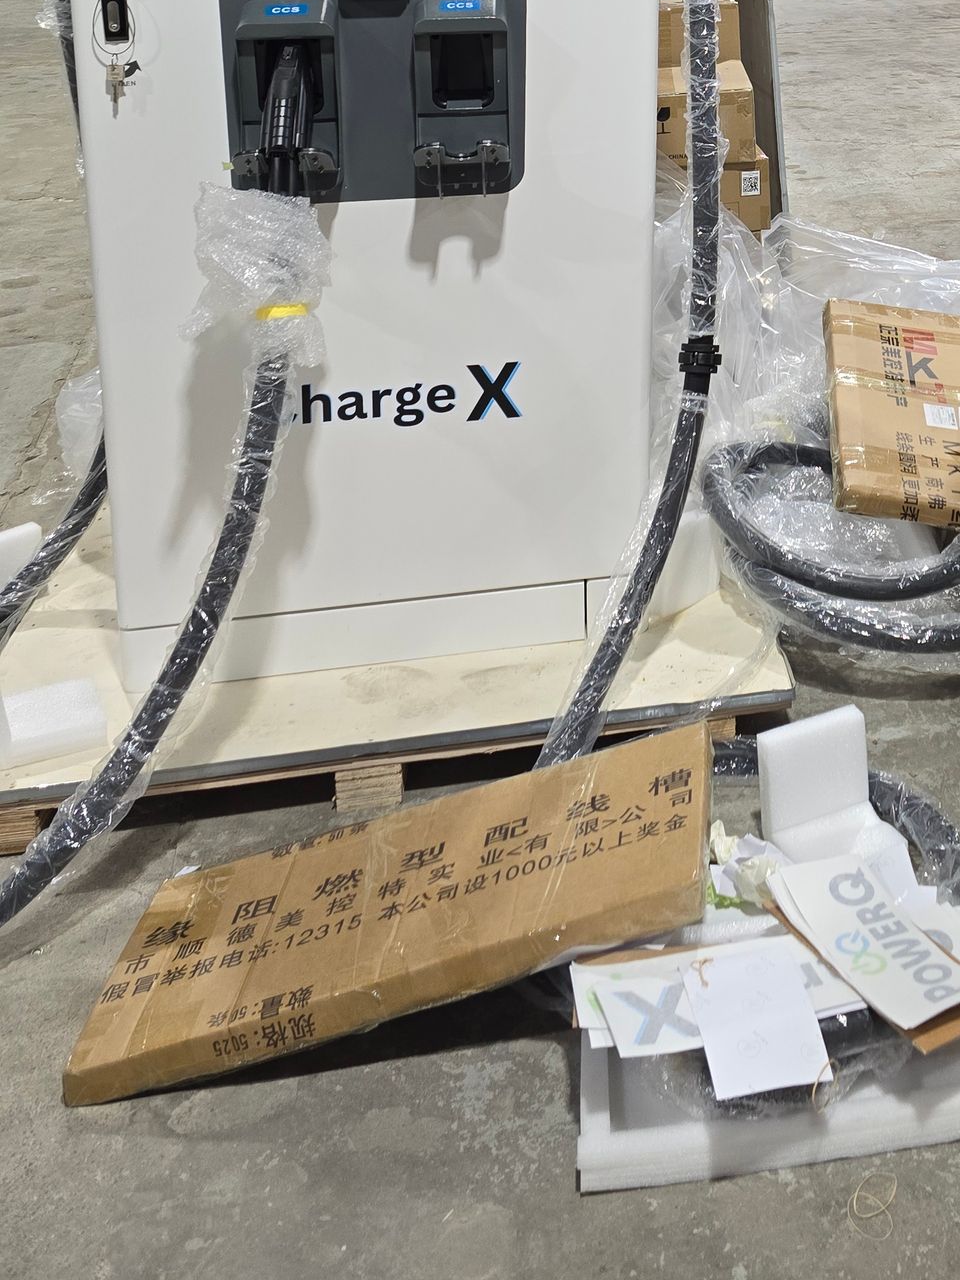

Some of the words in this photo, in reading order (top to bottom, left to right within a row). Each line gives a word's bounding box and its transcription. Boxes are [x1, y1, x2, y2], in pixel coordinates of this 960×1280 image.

[271, 5, 300, 14] CCS
[447, 0, 474, 10] CCS
[293, 382, 457, 427] harge
[466, 361, 523, 422] X
